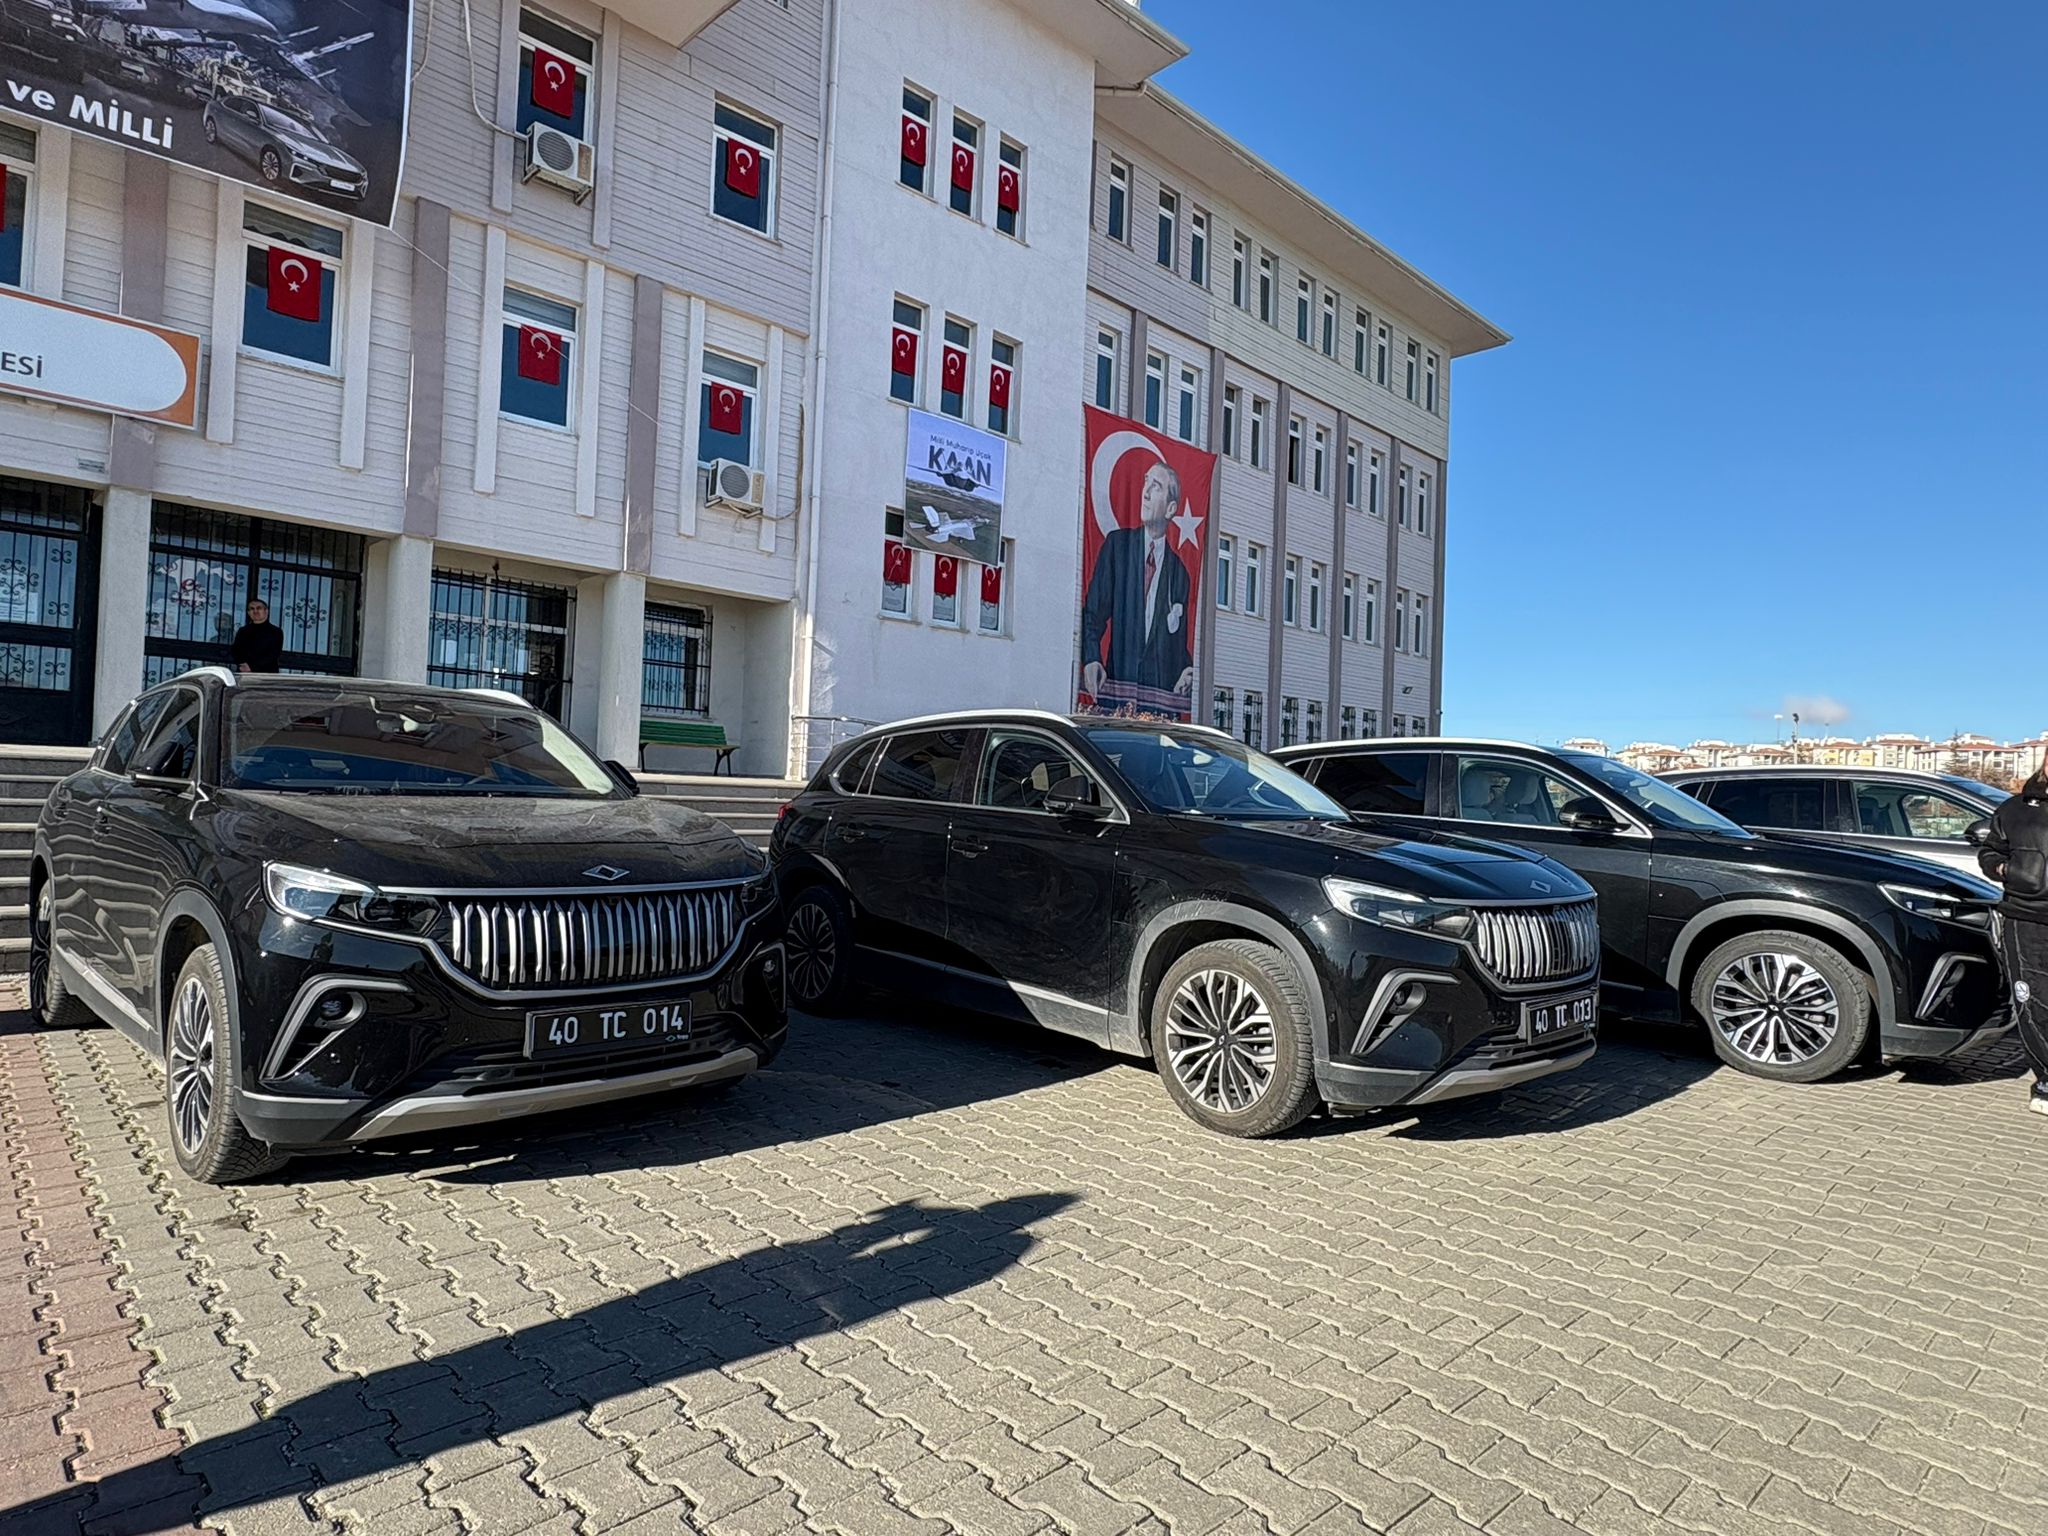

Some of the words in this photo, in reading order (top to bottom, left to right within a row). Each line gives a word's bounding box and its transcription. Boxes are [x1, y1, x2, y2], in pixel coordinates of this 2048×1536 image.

[7, 79, 56, 111] ve
[69, 94, 173, 149] MİLLİ
[928, 445, 992, 487] KAAN
[549, 1016, 579, 1045] 40
[600, 1011, 628, 1040] TC
[643, 1005, 684, 1034] 014
[1535, 1009, 1549, 1034] 40
[1555, 1004, 1568, 1029] TC
[1573, 998, 1592, 1022] 013
